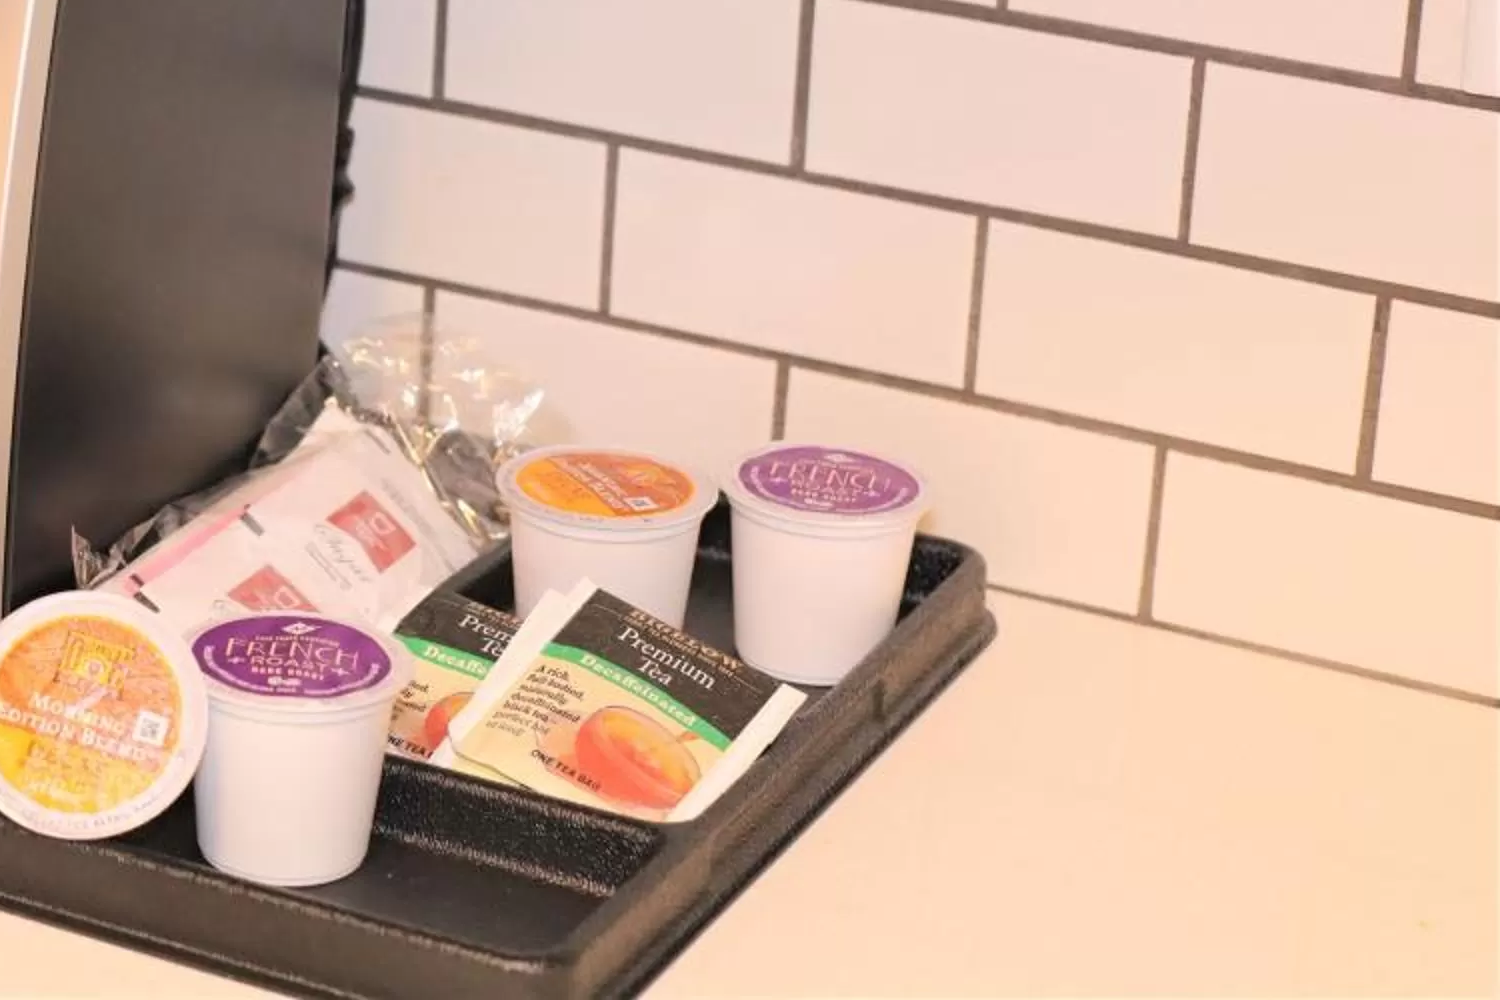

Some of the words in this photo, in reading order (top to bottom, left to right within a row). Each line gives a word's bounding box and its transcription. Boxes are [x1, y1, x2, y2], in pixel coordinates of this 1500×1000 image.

[225, 637, 359, 674] FRENCH
[250, 654, 328, 674] ROAST
[616, 626, 717, 690] Premium
[637, 655, 673, 687] Tea
[580, 653, 697, 728] Decaffeinated
[531, 749, 557, 766] ONE
[555, 761, 577, 778] TEA
